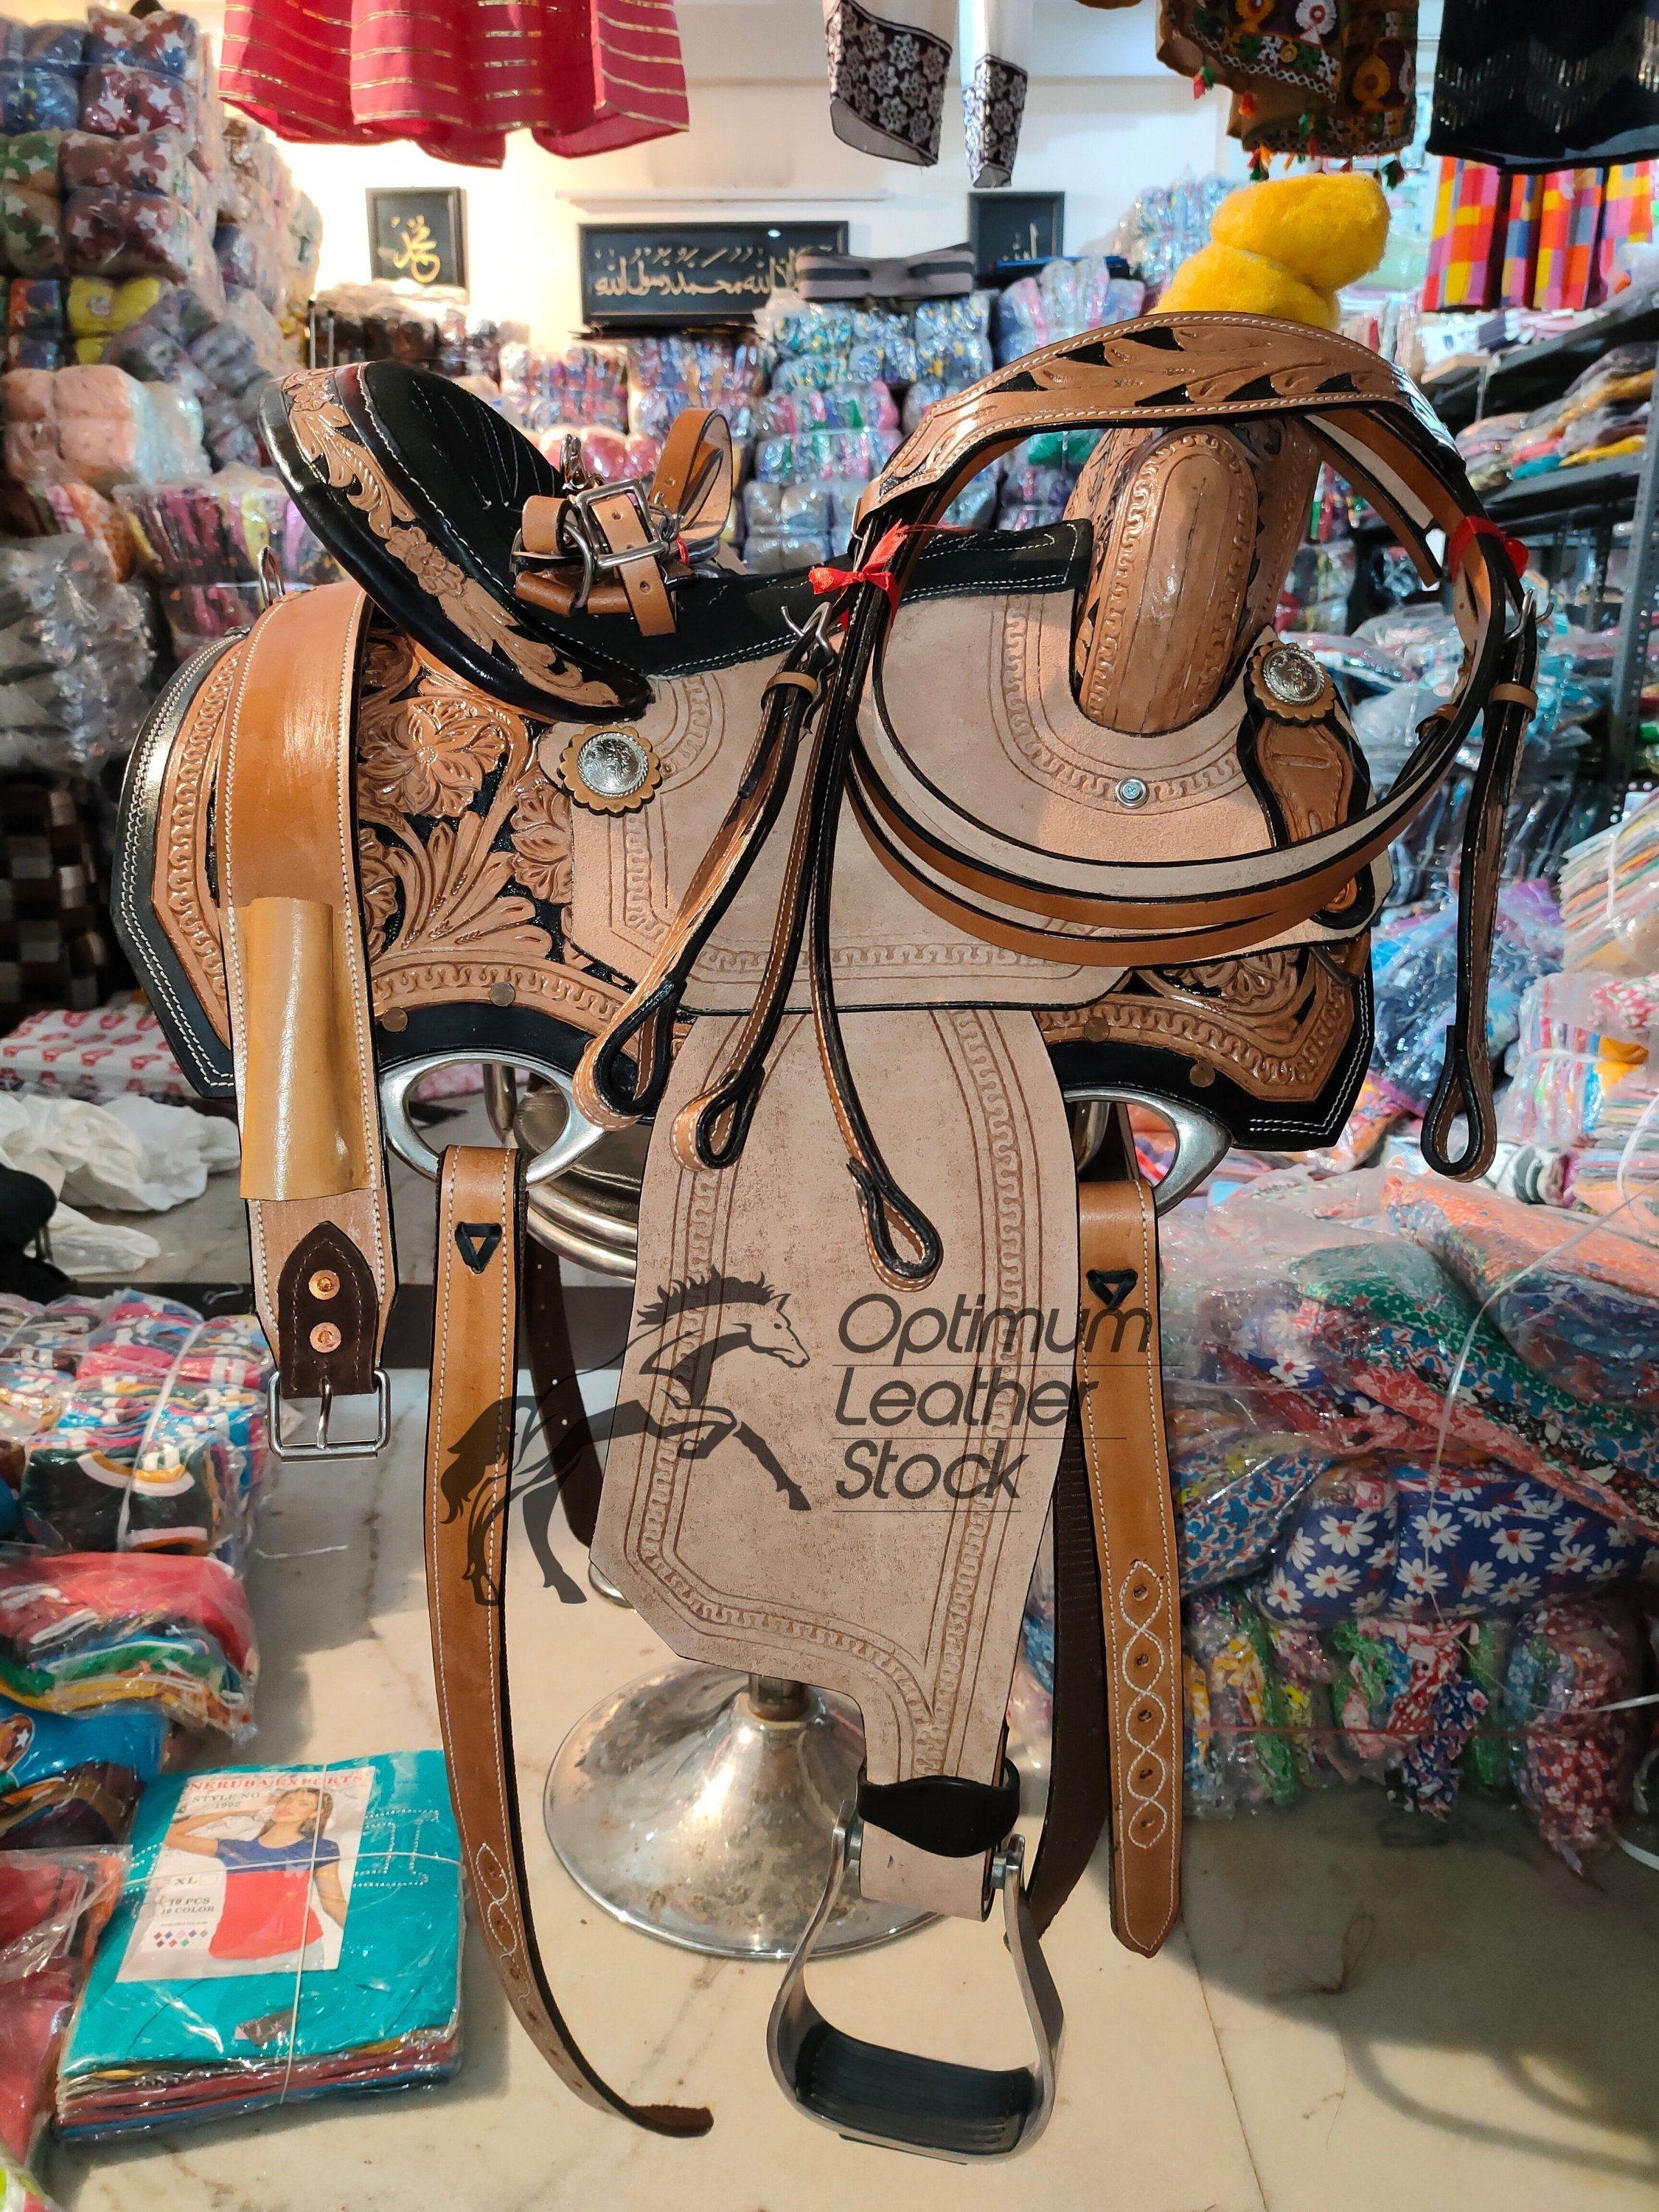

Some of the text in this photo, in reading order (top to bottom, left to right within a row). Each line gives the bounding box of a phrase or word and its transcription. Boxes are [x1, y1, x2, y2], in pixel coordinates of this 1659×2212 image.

[192, 1793, 237, 1804] STYLE
[174, 1876, 198, 1885] XL
[185, 1896, 211, 1905] PCS
[174, 1905, 215, 1915] COLOR
